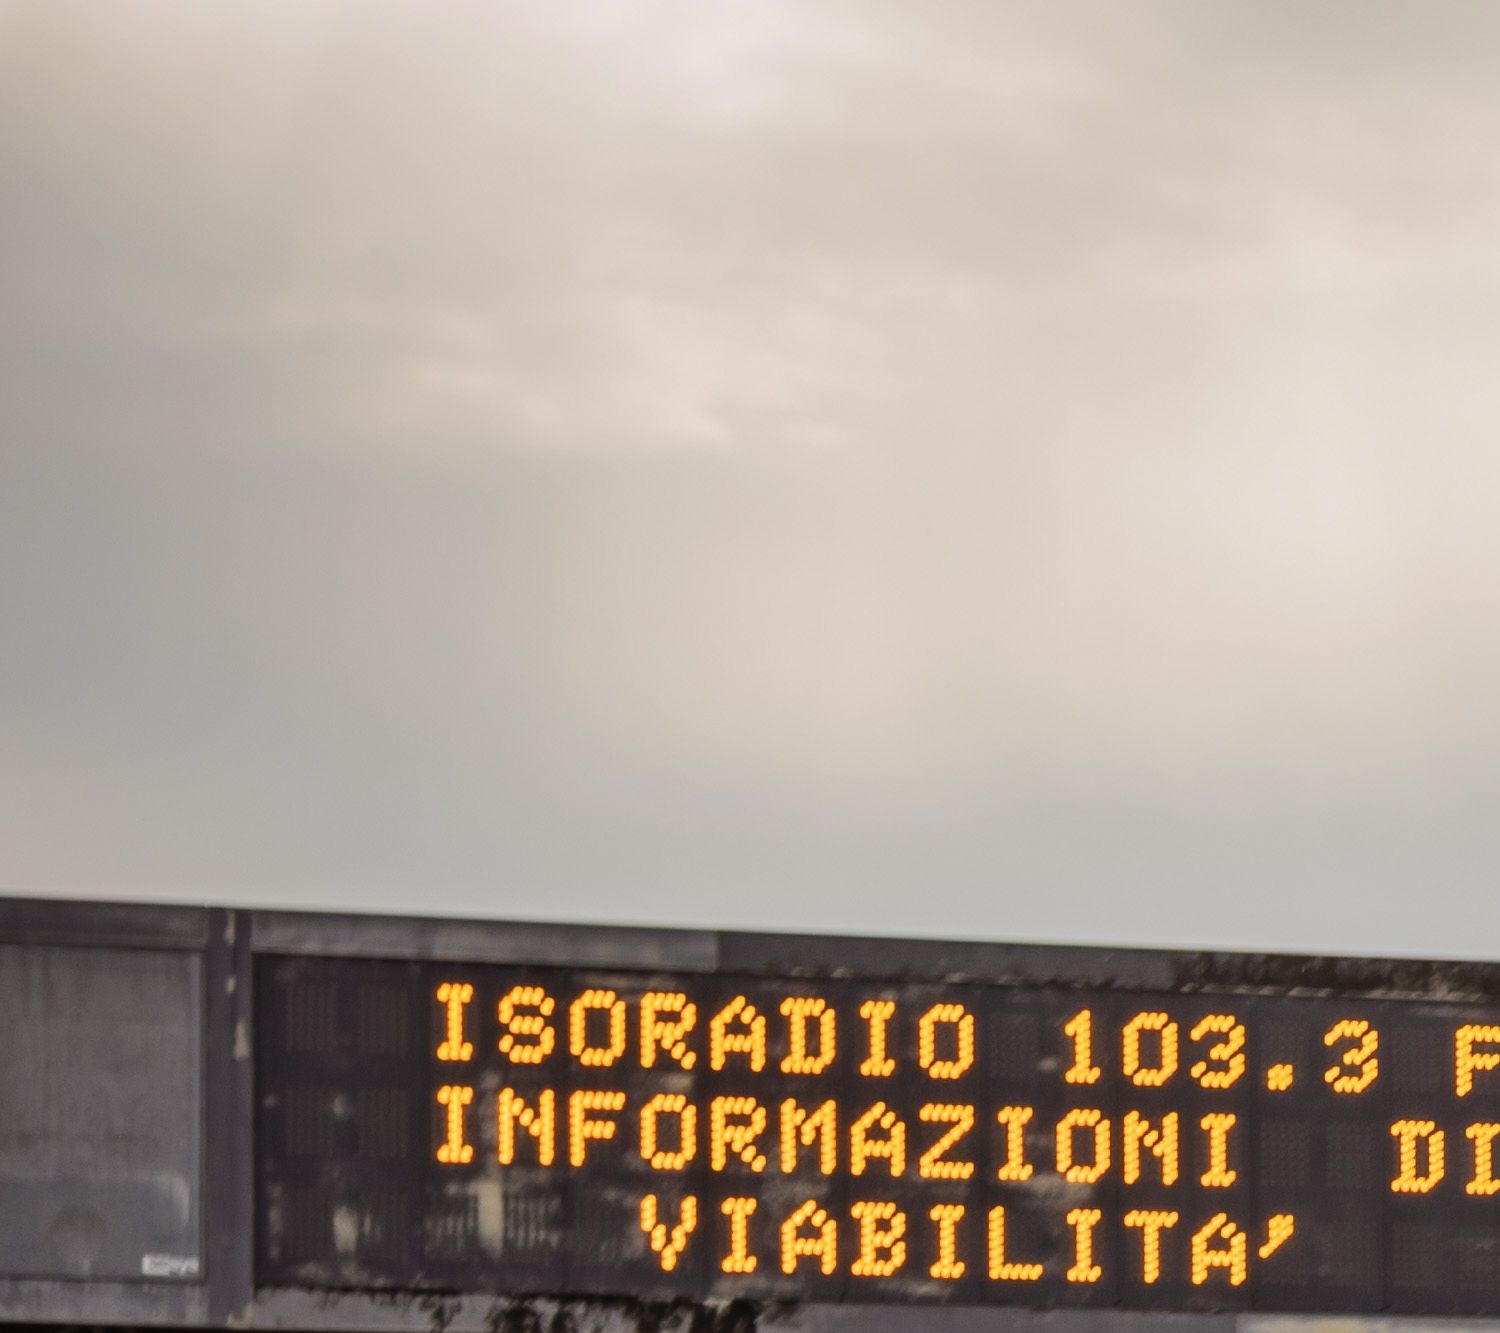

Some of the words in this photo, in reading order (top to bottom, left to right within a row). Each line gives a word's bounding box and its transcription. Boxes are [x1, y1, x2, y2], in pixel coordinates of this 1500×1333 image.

[436, 982, 975, 1080] ISORADIO
[1063, 1008, 1379, 1094] 103.3
[436, 1084, 1237, 1188] INFORMAZIONI
